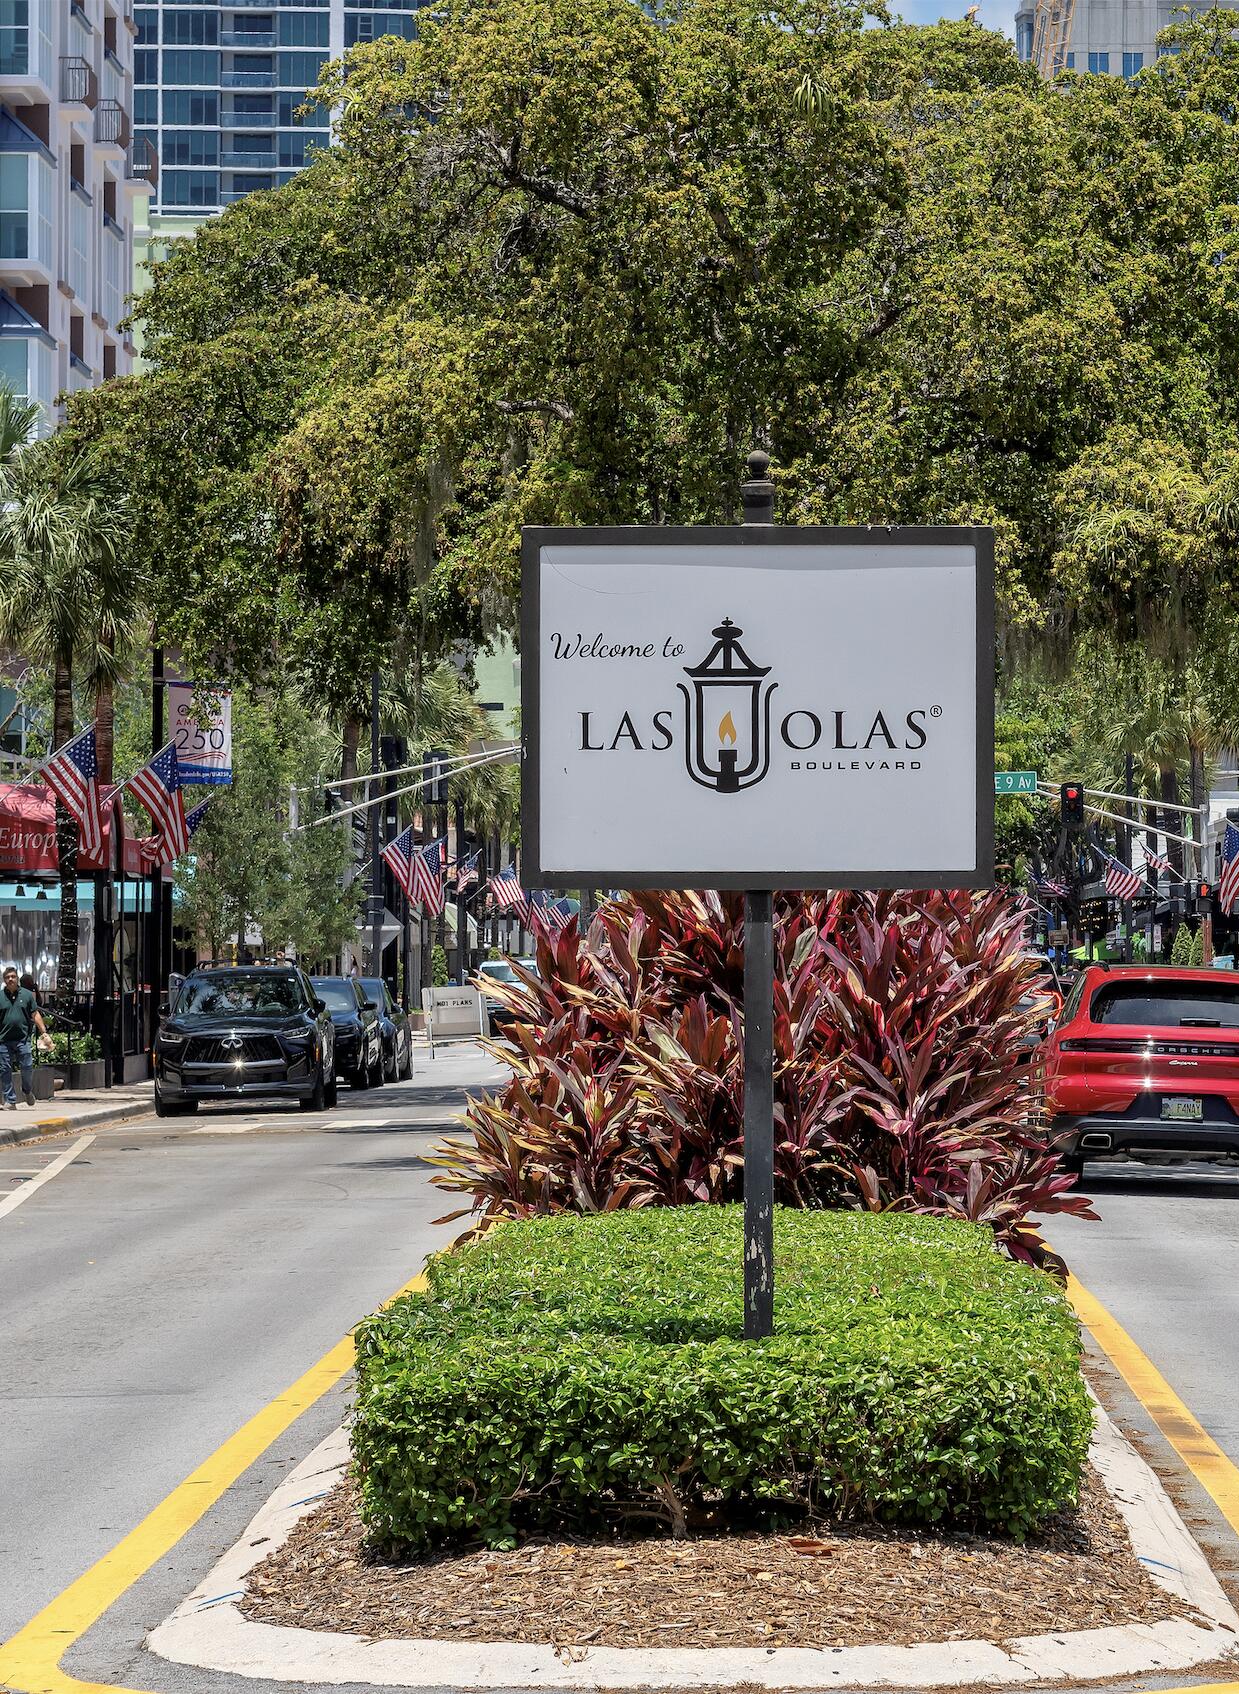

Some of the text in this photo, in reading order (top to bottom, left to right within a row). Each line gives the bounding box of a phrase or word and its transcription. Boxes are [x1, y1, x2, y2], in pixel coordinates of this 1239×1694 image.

[550, 632, 687, 660] Welcome to
[176, 728, 225, 750] 250
[577, 710, 673, 751] LAS
[790, 761, 921, 770] BOULEVARD
[1005, 776, 1013, 789] 9
[1018, 776, 1032, 789] Av
[0, 827, 59, 857] Europ
[1146, 1046, 1221, 1054] PORSCHE
